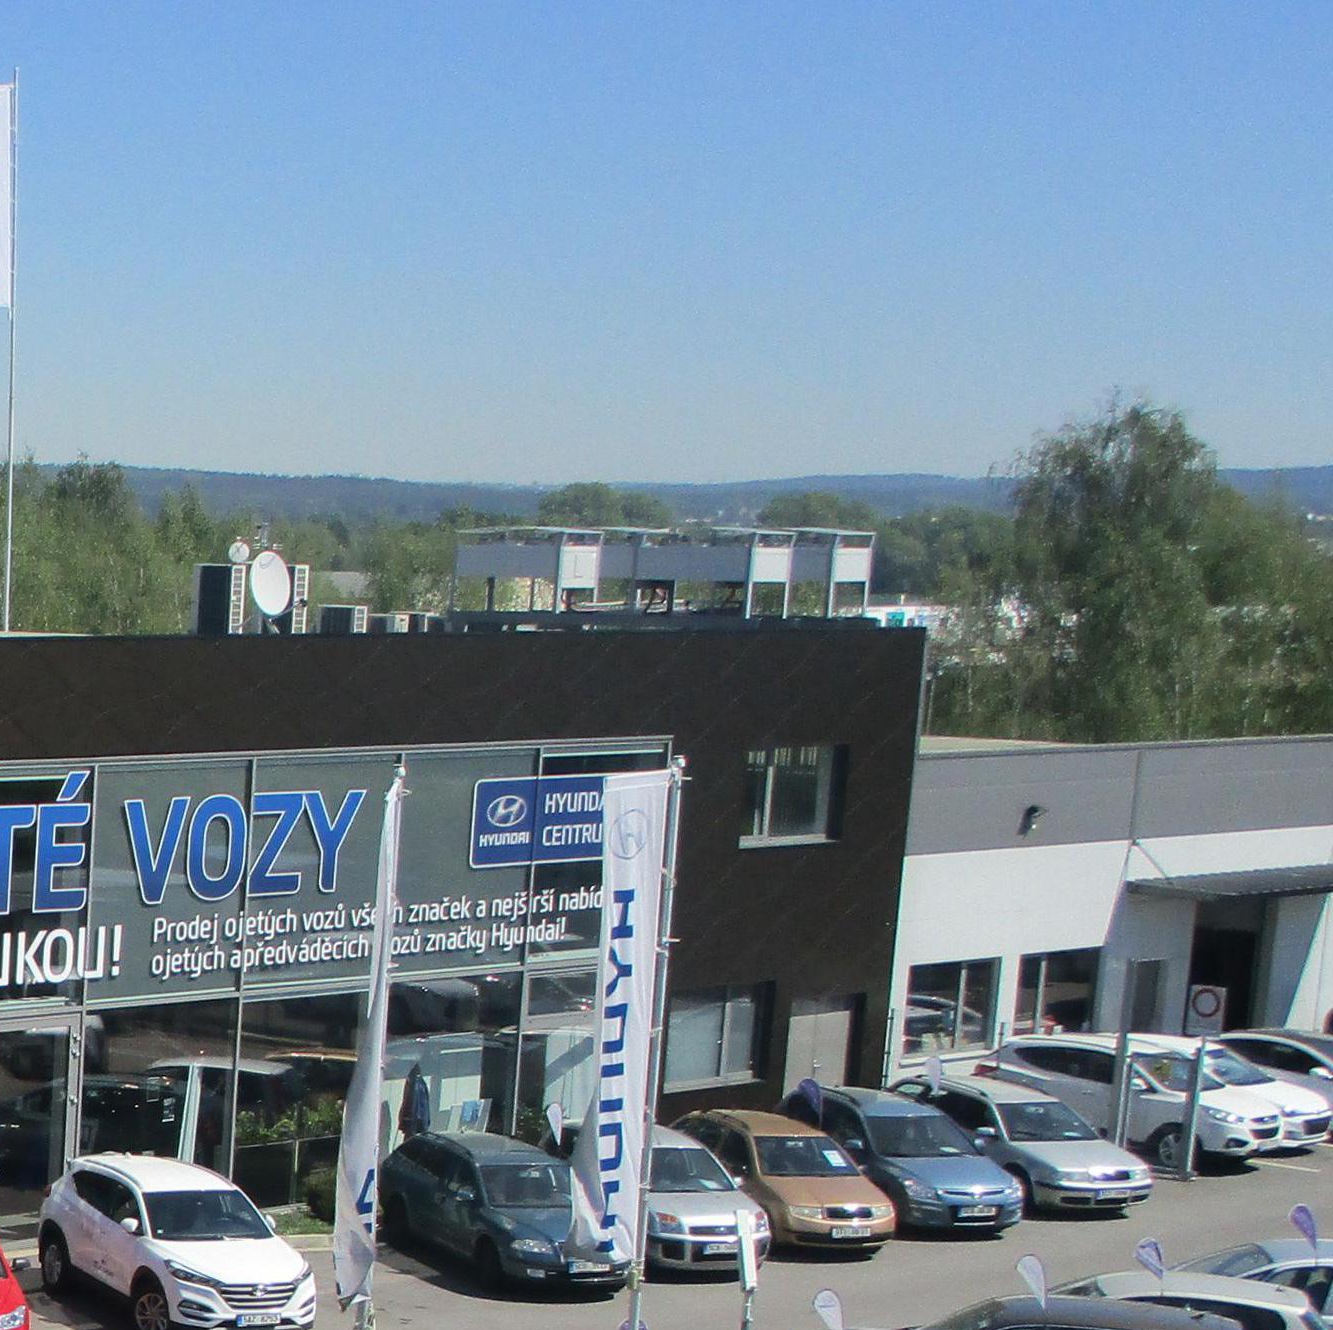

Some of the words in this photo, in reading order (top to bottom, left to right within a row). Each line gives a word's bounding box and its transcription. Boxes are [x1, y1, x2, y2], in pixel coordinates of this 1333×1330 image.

[544, 791, 605, 815] HYUNDA
[122, 788, 367, 906] VOZY
[478, 830, 531, 848] HYUNDAI
[541, 822, 603, 847] CENTRU
[152, 912, 219, 946] Prodej
[224, 908, 298, 943] ojetých
[302, 902, 346, 933] vozů
[408, 895, 472, 924] značek
[475, 899, 487, 919] a
[151, 944, 225, 981] ojetých
[391, 929, 421, 955] ozů
[425, 923, 487, 953] značky
[491, 916, 567, 950] Hyundai!
